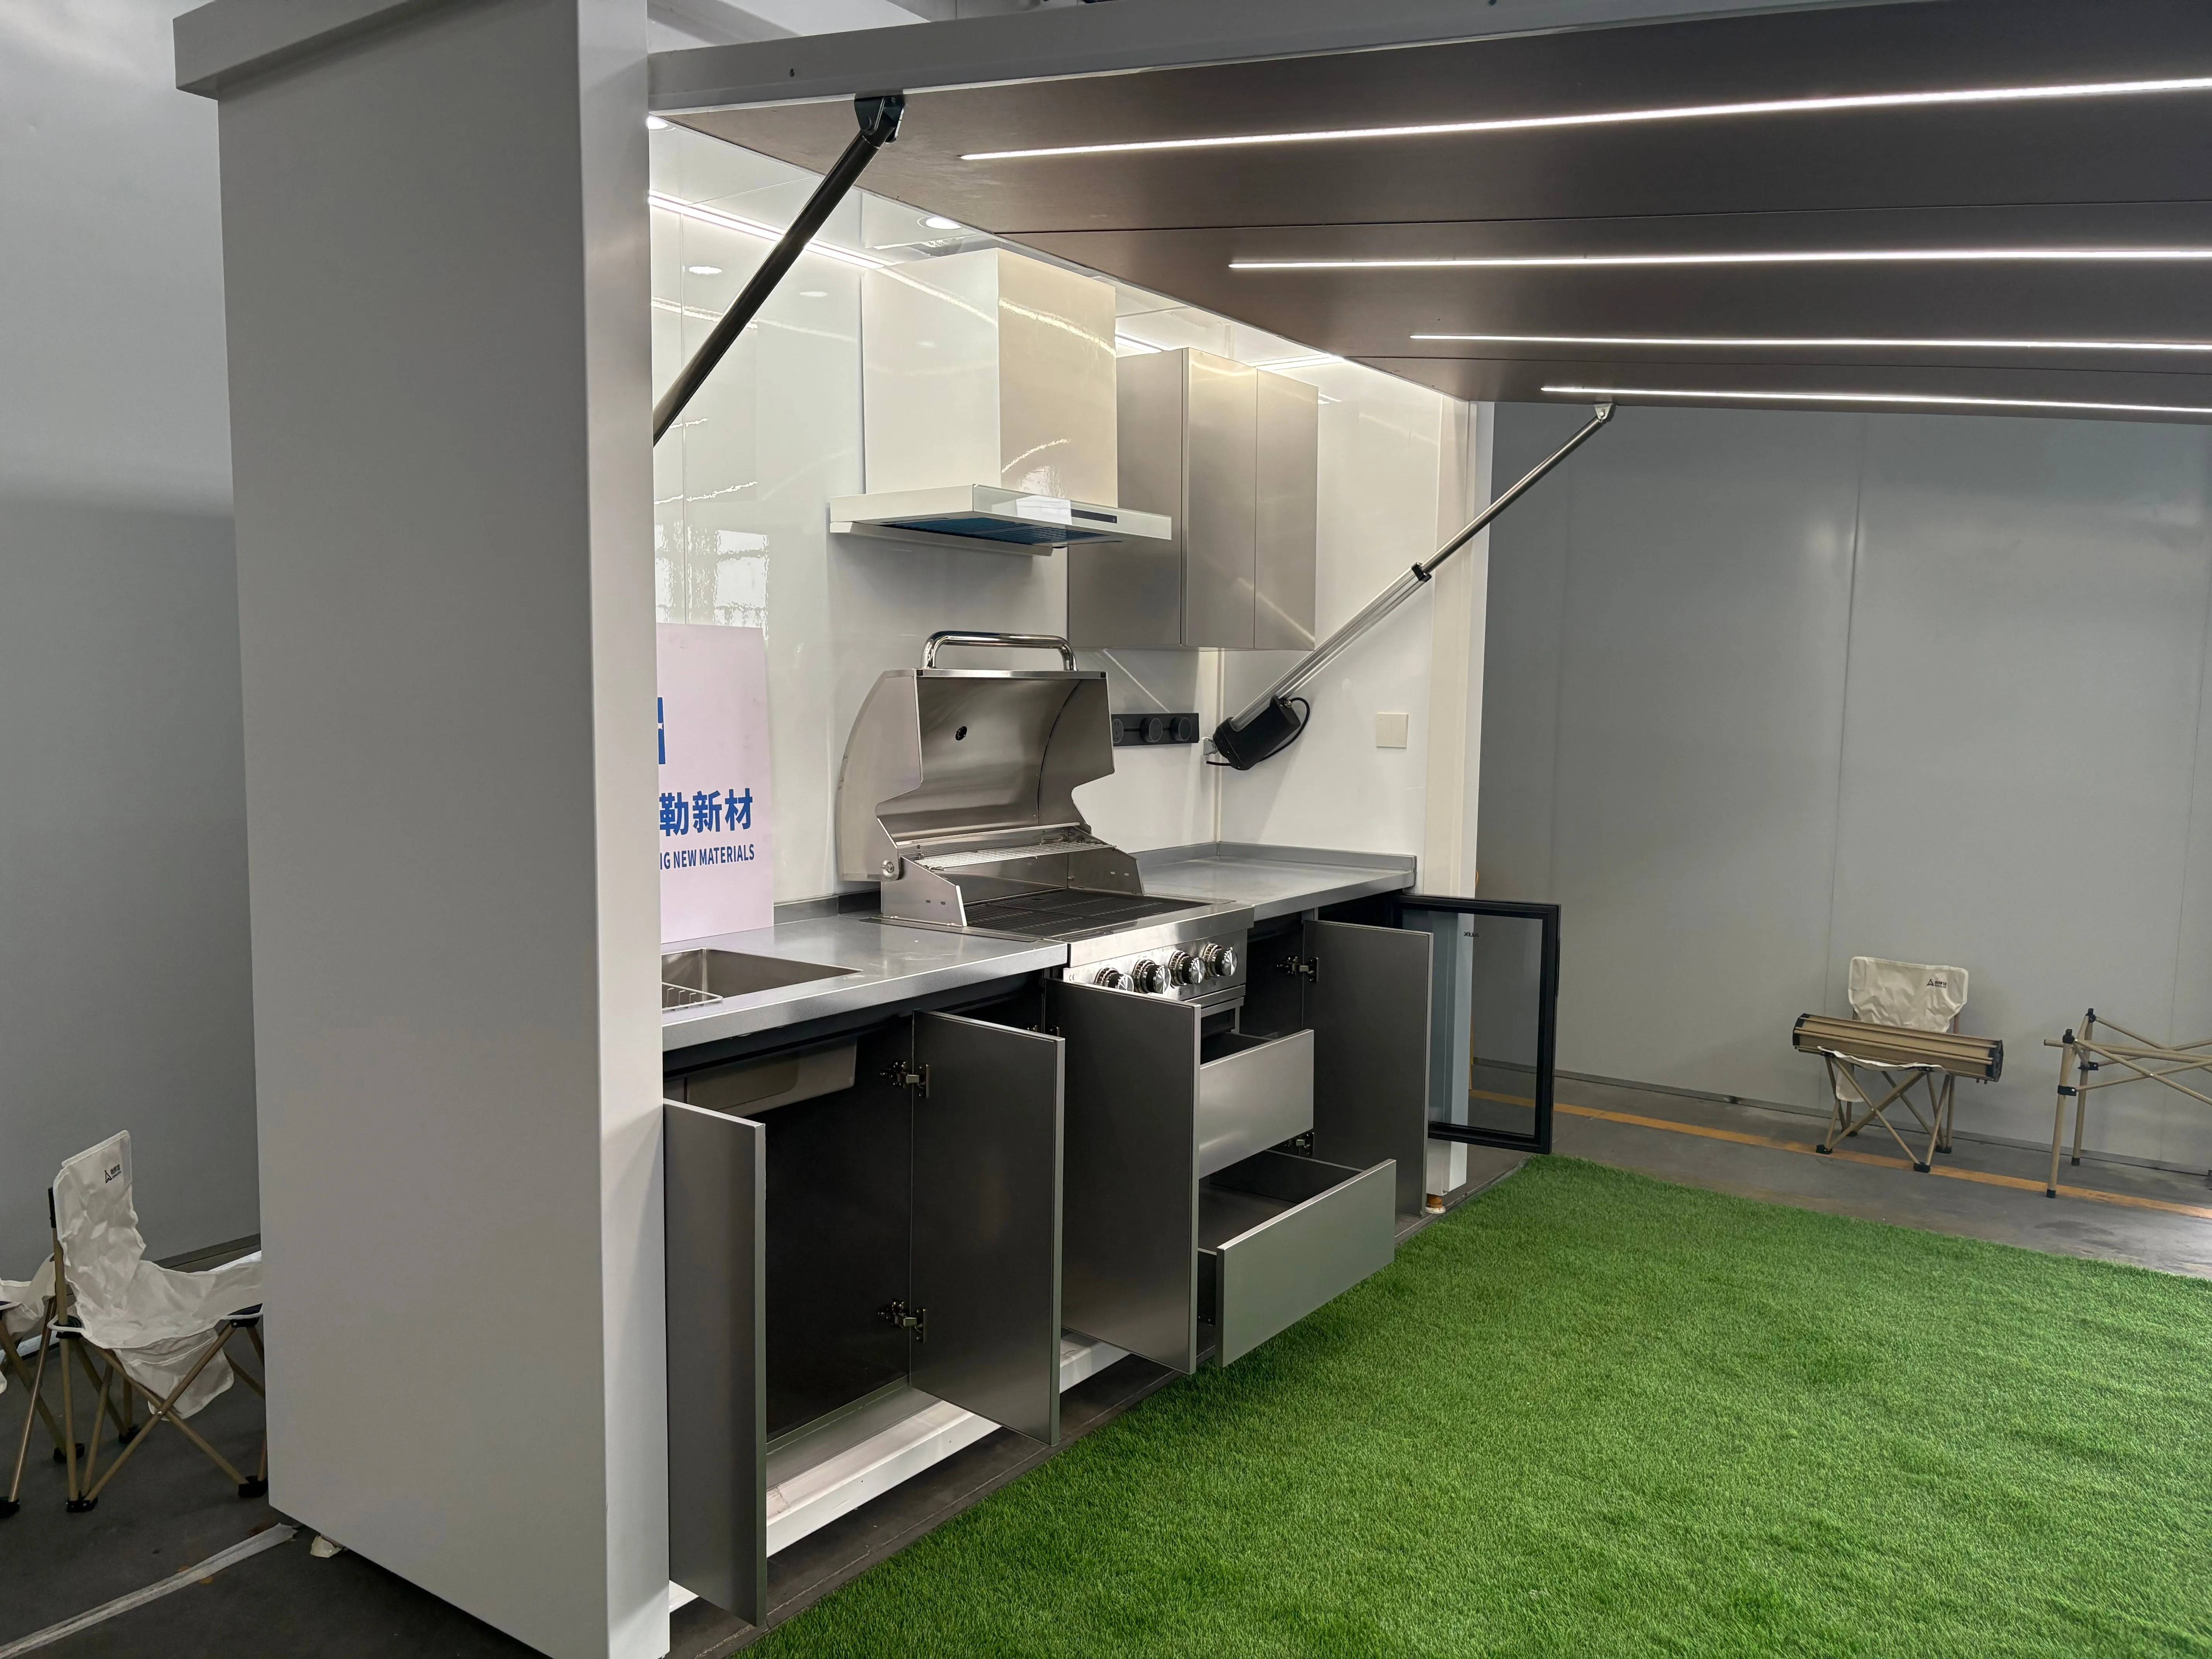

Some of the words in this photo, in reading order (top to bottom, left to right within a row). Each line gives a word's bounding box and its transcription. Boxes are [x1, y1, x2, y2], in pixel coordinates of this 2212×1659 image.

[659, 788, 753, 836] 勒新材
[673, 849, 696, 868] NEW
[699, 844, 754, 866] MATERIALS
